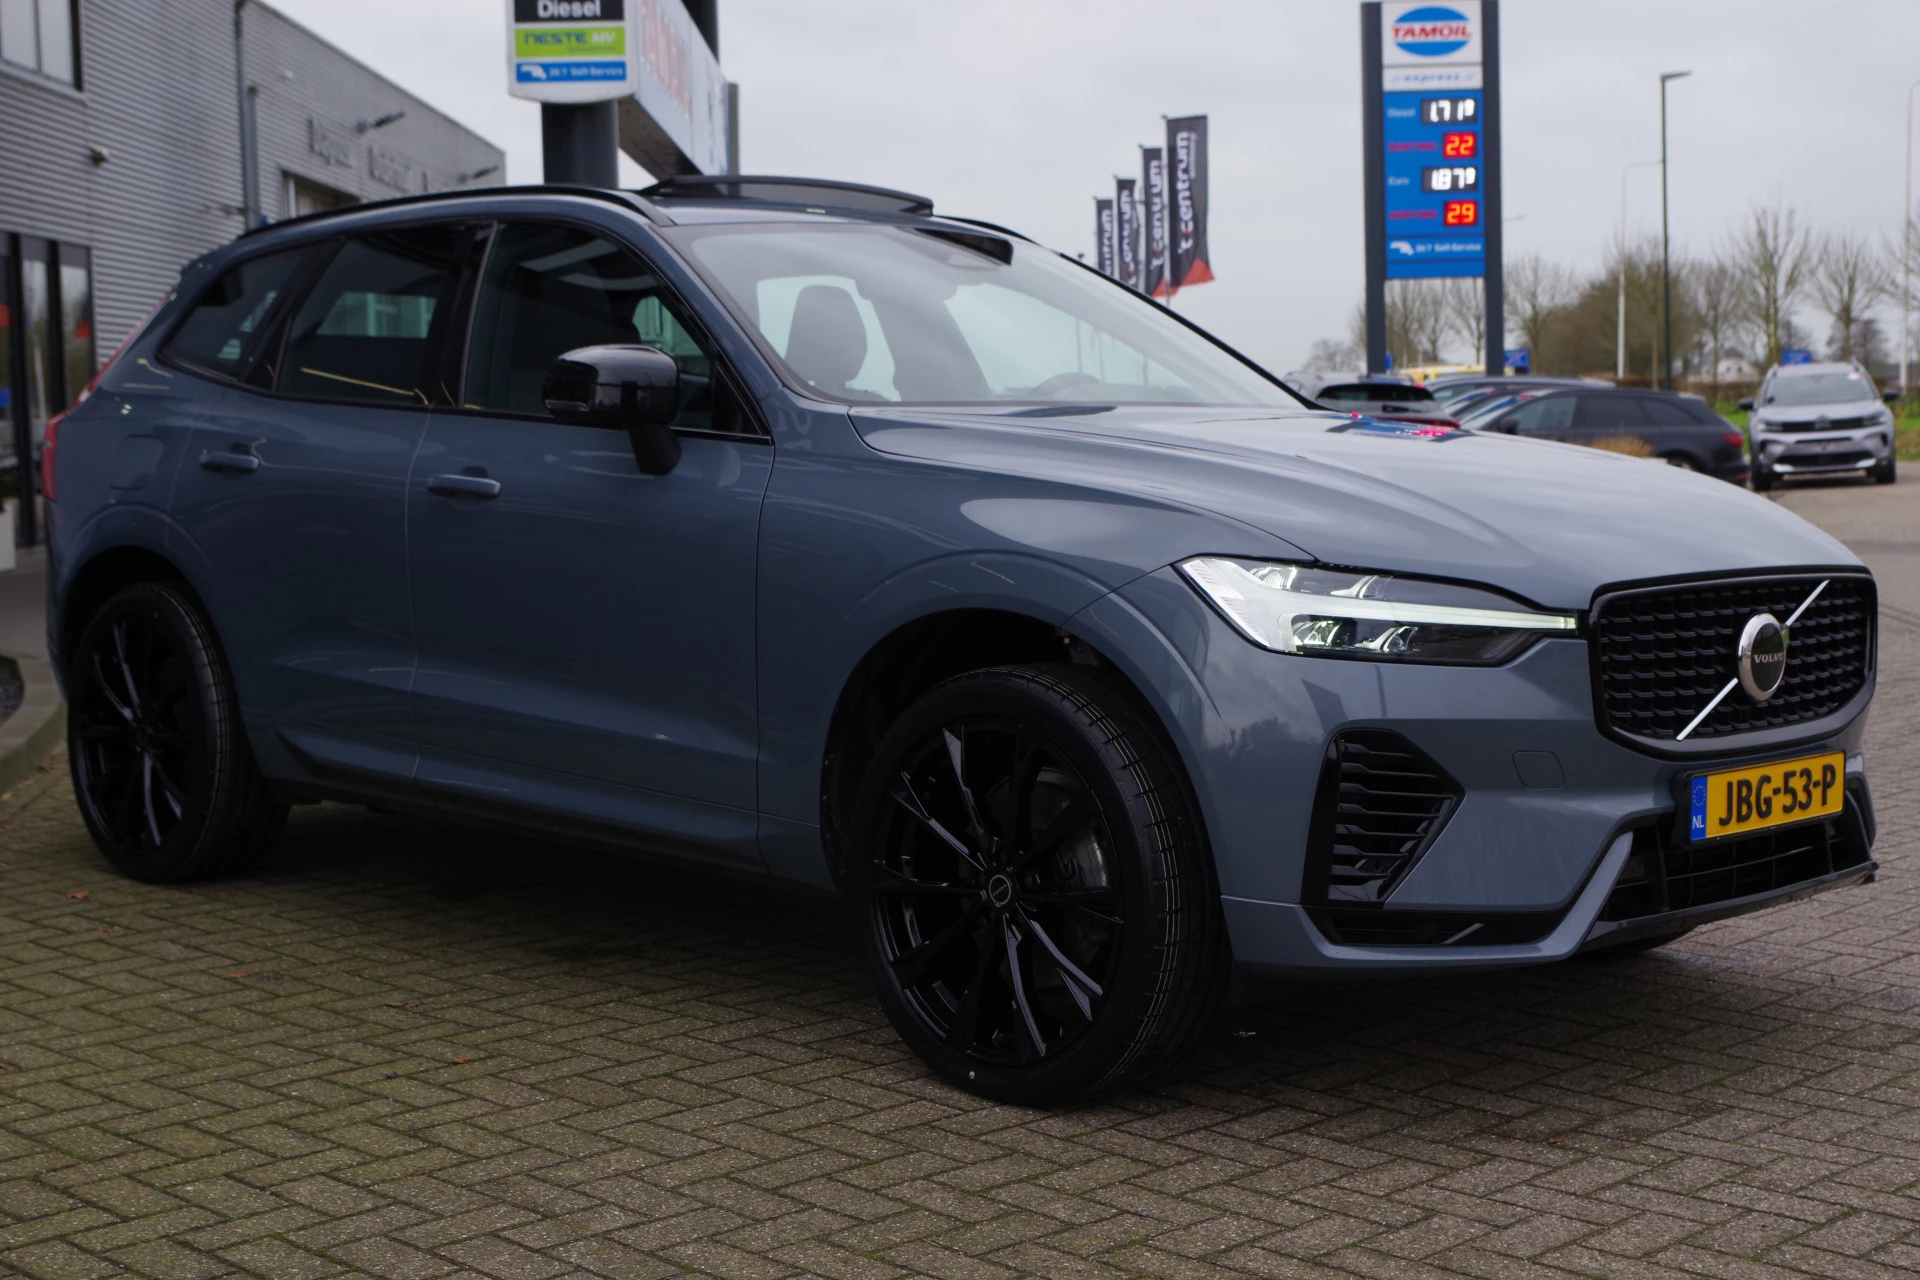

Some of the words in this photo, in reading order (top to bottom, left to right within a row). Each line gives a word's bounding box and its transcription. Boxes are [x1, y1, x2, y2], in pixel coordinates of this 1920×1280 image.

[537, 0, 601, 18] Diesel
[524, 32, 587, 45] NESTE
[1393, 22, 1472, 40] TAMOIL
[1387, 108, 1415, 118] Diesel
[1445, 134, 1475, 156] 22
[1175, 131, 1194, 236] centrum
[1446, 203, 1475, 226] 29
[1753, 652, 1784, 663] VOLVO
[1719, 764, 1837, 826] JBG-53-P
[1692, 815, 1705, 829] NL
